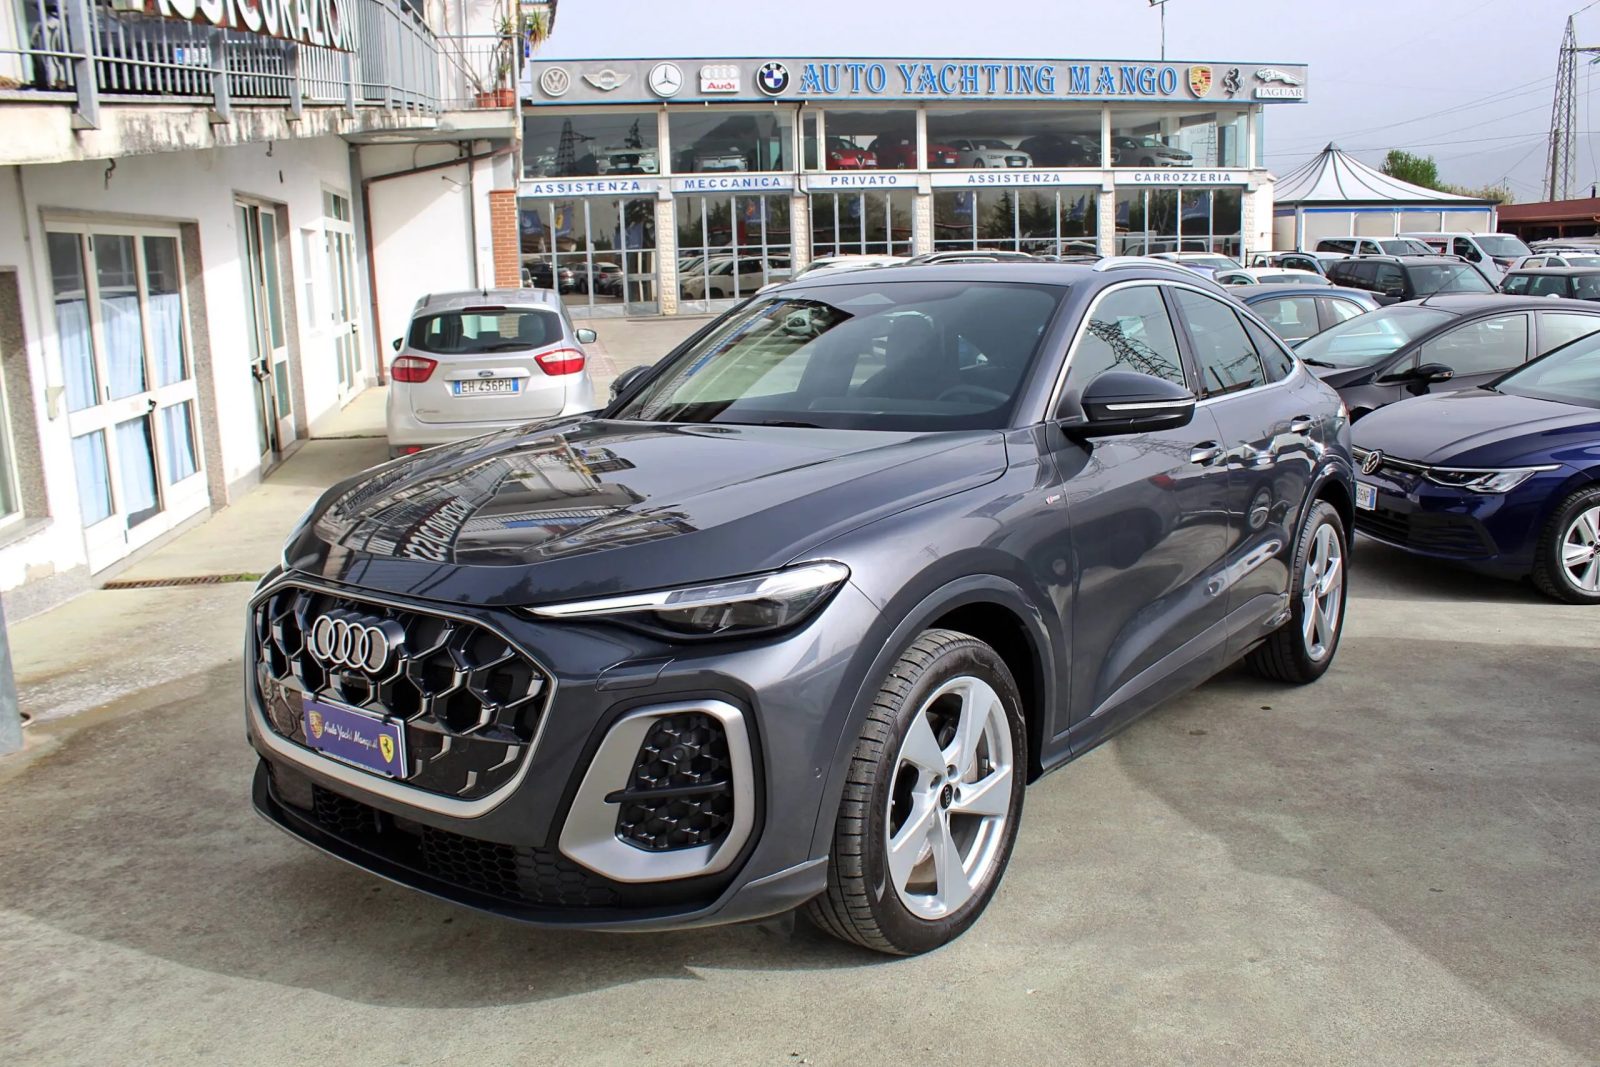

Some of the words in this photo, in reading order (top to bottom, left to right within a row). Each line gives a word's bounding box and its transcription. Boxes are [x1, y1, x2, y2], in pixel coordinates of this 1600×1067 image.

[799, 63, 887, 93] AUTO
[898, 63, 1056, 94] YACHTING
[1068, 65, 1178, 95] MANGO
[707, 82, 735, 90] Audi
[684, 177, 782, 189] MECCANICA
[830, 175, 898, 186] PRIVATO
[967, 173, 1062, 184] ASSISTENZA
[1134, 172, 1231, 183] CARROZZERIA
[534, 181, 642, 195] ASSISTENZA
